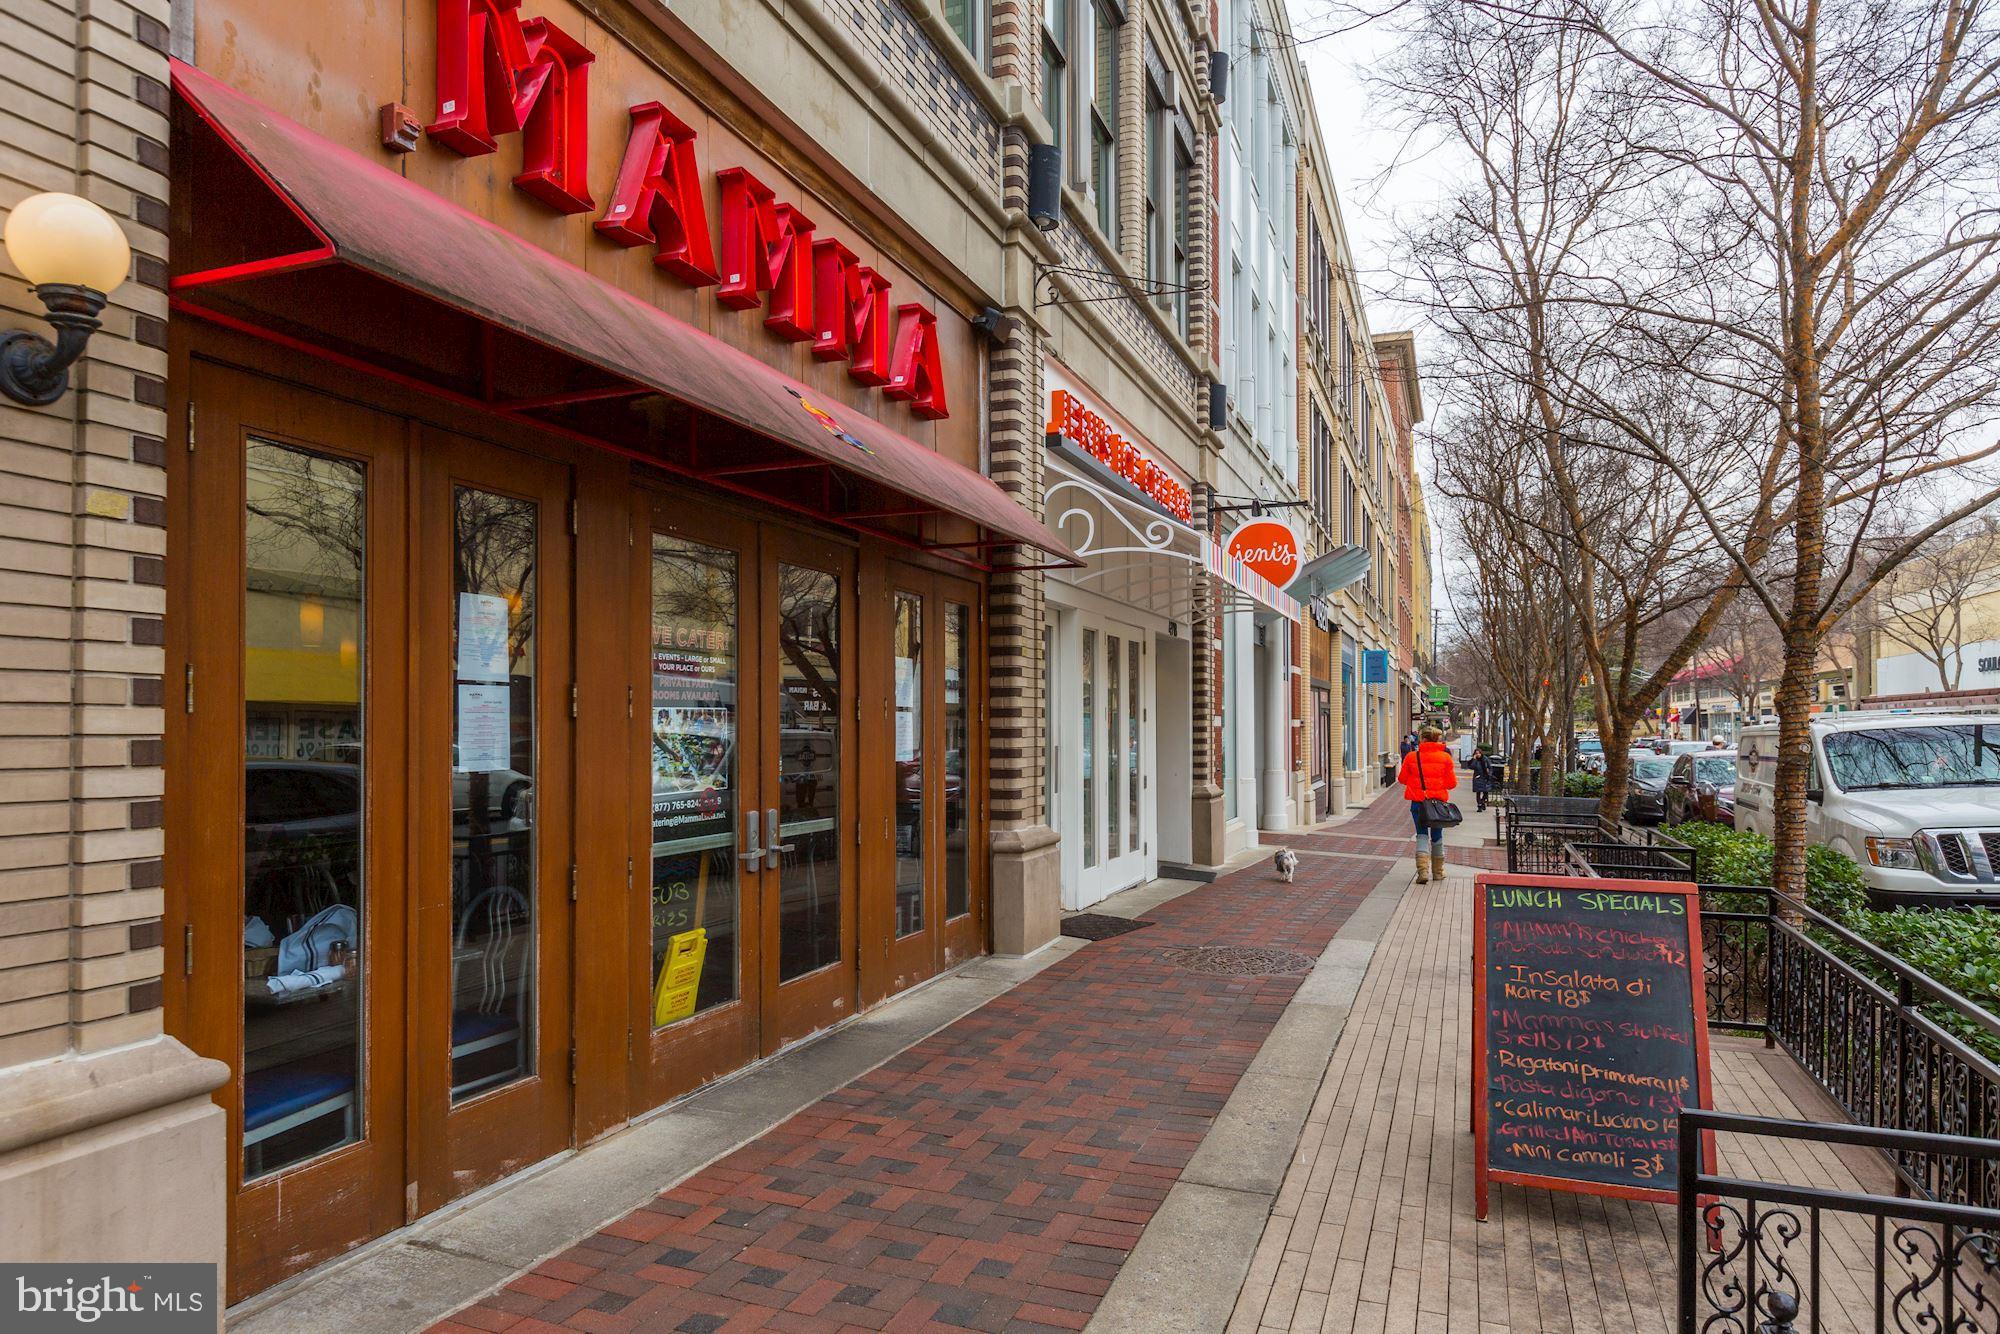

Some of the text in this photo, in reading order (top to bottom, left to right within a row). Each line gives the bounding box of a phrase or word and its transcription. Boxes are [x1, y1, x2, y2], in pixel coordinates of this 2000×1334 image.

[425, 0, 948, 420] MAMMA
[1234, 542, 1298, 566] jeni's
[676, 628, 730, 651] CATER!
[658, 653, 681, 662] EVENTS
[685, 655, 703, 663] LARGE
[709, 657, 727, 665] SMALL
[659, 663, 676, 671] YOUR
[676, 664, 694, 672] PLACE
[659, 678, 689, 688] PRIVATE
[1490, 889, 1686, 915] LUNCH SPECIALS
[1504, 983, 1552, 1001] Mare
[1510, 965, 1652, 996] Insalata di
[1499, 1050, 1579, 1076] Rigatoni
[1581, 1063, 1667, 1091] primavera
[1500, 1074, 1557, 1098] Pasta
[1503, 1099, 1591, 1124] Calimari
[1512, 1142, 1552, 1160] Mini
[1631, 1153, 1666, 1179] 3$
